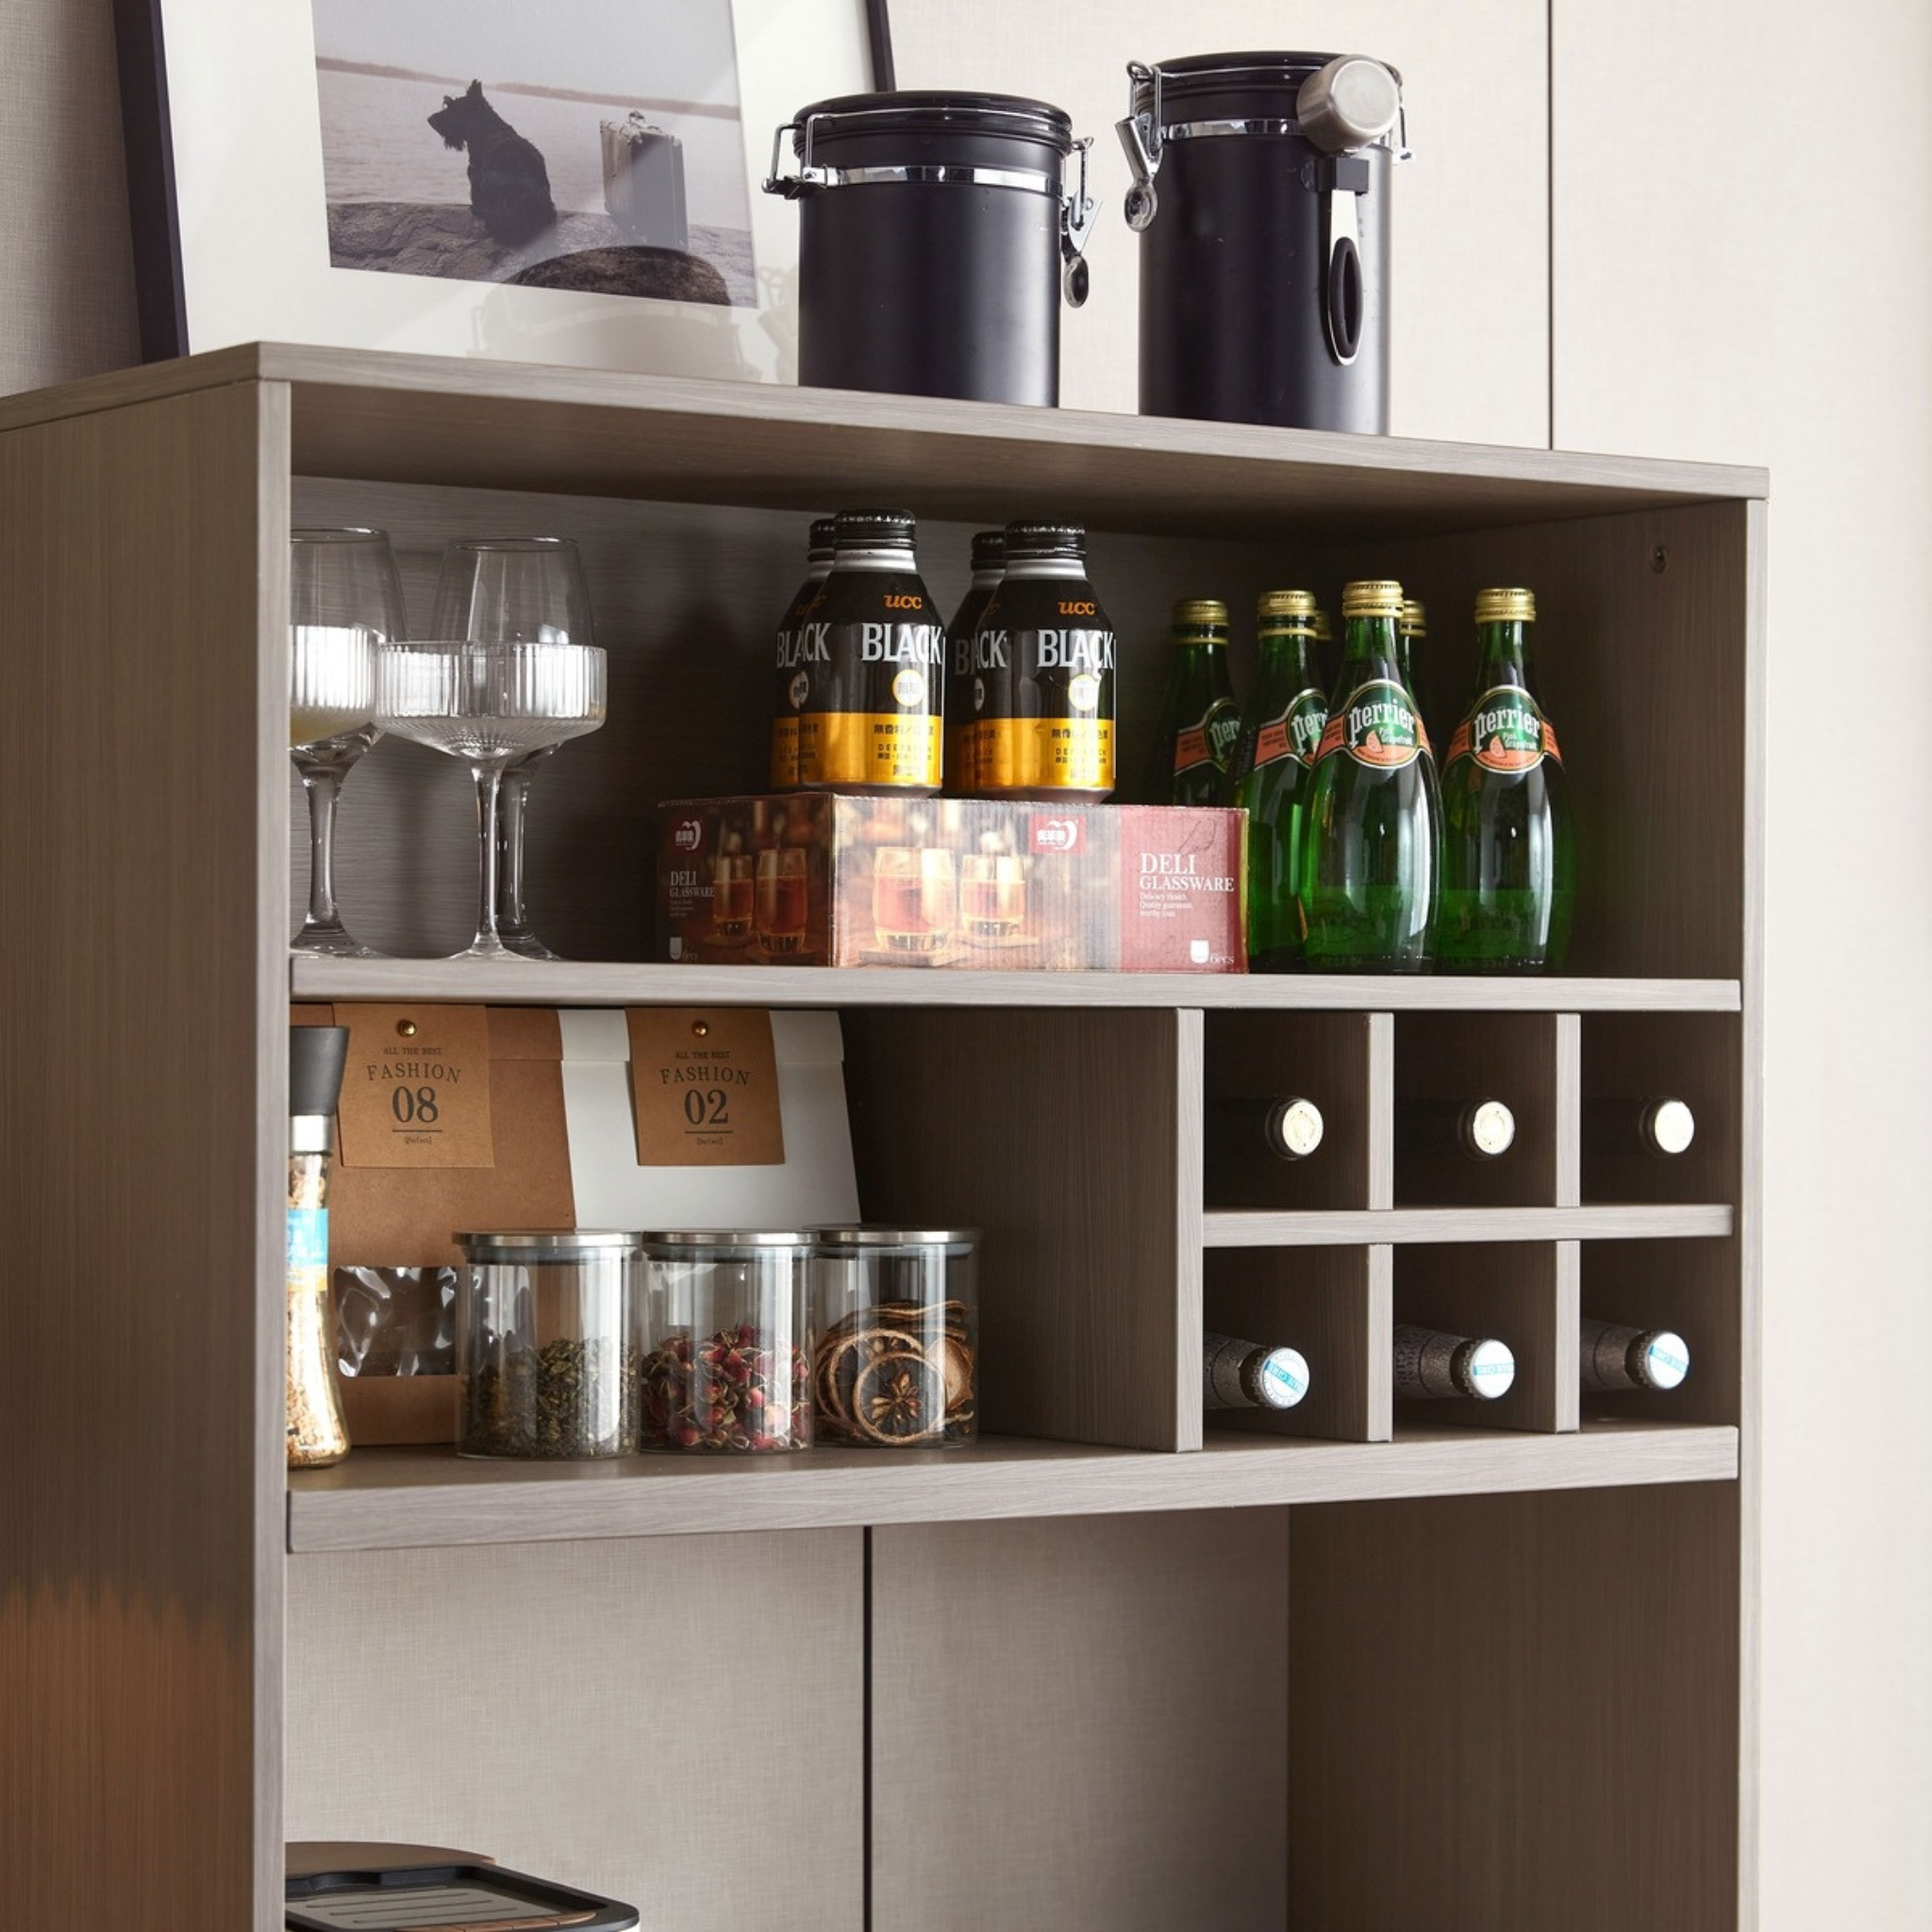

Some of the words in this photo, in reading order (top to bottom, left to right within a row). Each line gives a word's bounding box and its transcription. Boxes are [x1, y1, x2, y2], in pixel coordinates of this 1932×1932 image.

[861, 623, 942, 665] BLACK
[1037, 628, 1114, 670] BLACK
[1140, 852, 1197, 875] DELI
[670, 870, 697, 887] DELI
[1139, 875, 1235, 891] GLASSWARE
[669, 887, 716, 897] GLASSWARE
[383, 1047, 398, 1056] ALL
[402, 1047, 420, 1056] THE
[422, 1047, 442, 1056] BEST
[675, 1051, 690, 1059] ALL
[692, 1051, 709, 1059] THE
[711, 1051, 731, 1059] BEST
[367, 1062, 461, 1084] FASHION
[659, 1067, 751, 1086] FASHION
[391, 1086, 439, 1124] 08
[684, 1089, 729, 1125] 02
